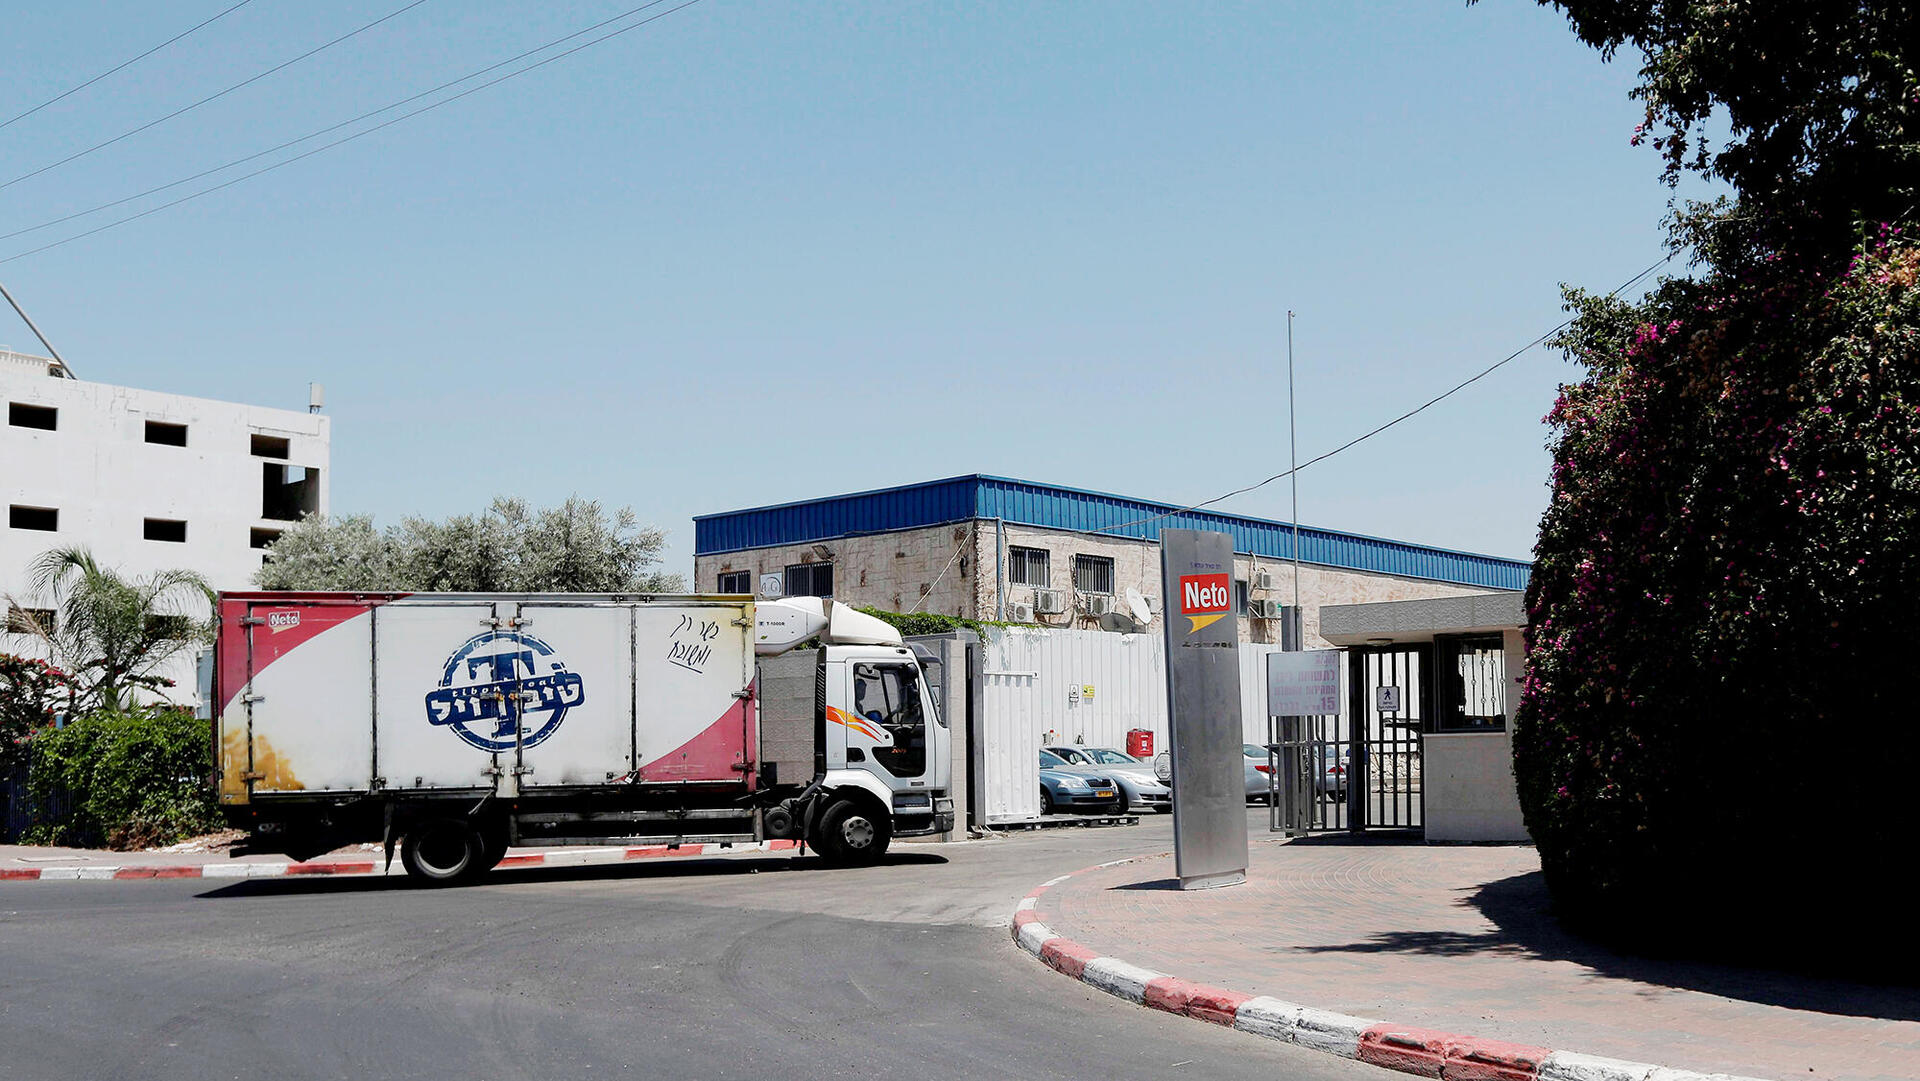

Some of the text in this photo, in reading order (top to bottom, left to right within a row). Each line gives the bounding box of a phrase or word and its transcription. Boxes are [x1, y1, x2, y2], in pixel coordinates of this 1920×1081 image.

[1184, 581, 1228, 609] Neto
[271, 614, 298, 625] Neto
[497, 683, 580, 717] טיבן
[1321, 696, 1336, 710] 15
